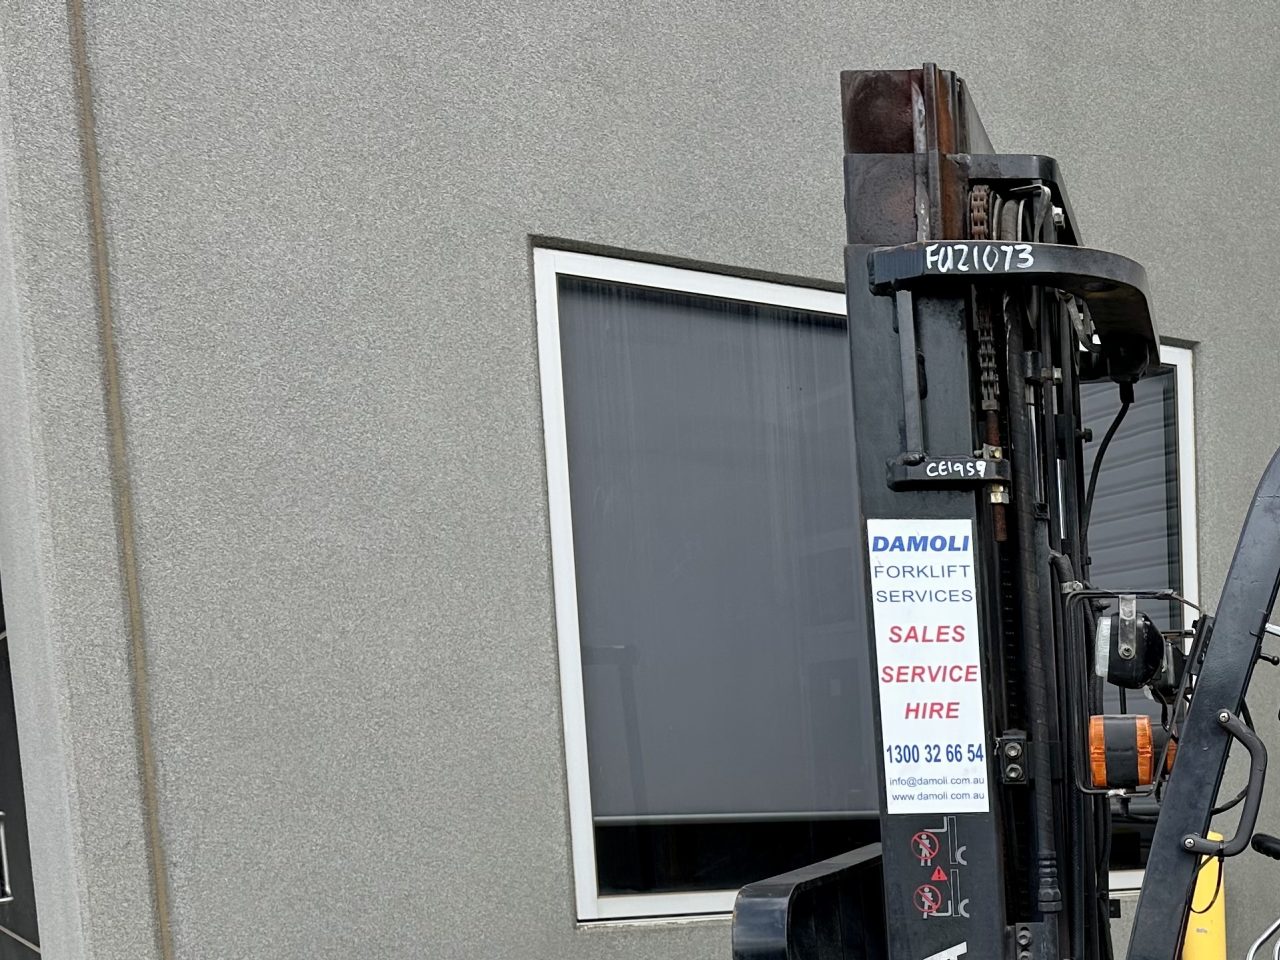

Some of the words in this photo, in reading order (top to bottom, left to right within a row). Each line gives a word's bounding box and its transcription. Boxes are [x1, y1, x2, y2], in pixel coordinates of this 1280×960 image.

[872, 535, 970, 552] DAMOLI
[874, 565, 971, 578] FORKLIFT
[876, 589, 973, 603] SERVICES
[888, 625, 966, 643] SALES
[881, 665, 978, 683] SERVICE
[904, 702, 960, 719] HIRE
[886, 745, 920, 764] 1300
[924, 744, 942, 763] 32
[945, 743, 963, 763] 66
[967, 743, 984, 763] 54
[889, 776, 985, 788] info@damoli.com.au
[891, 791, 985, 801] www.damoli.com.au
